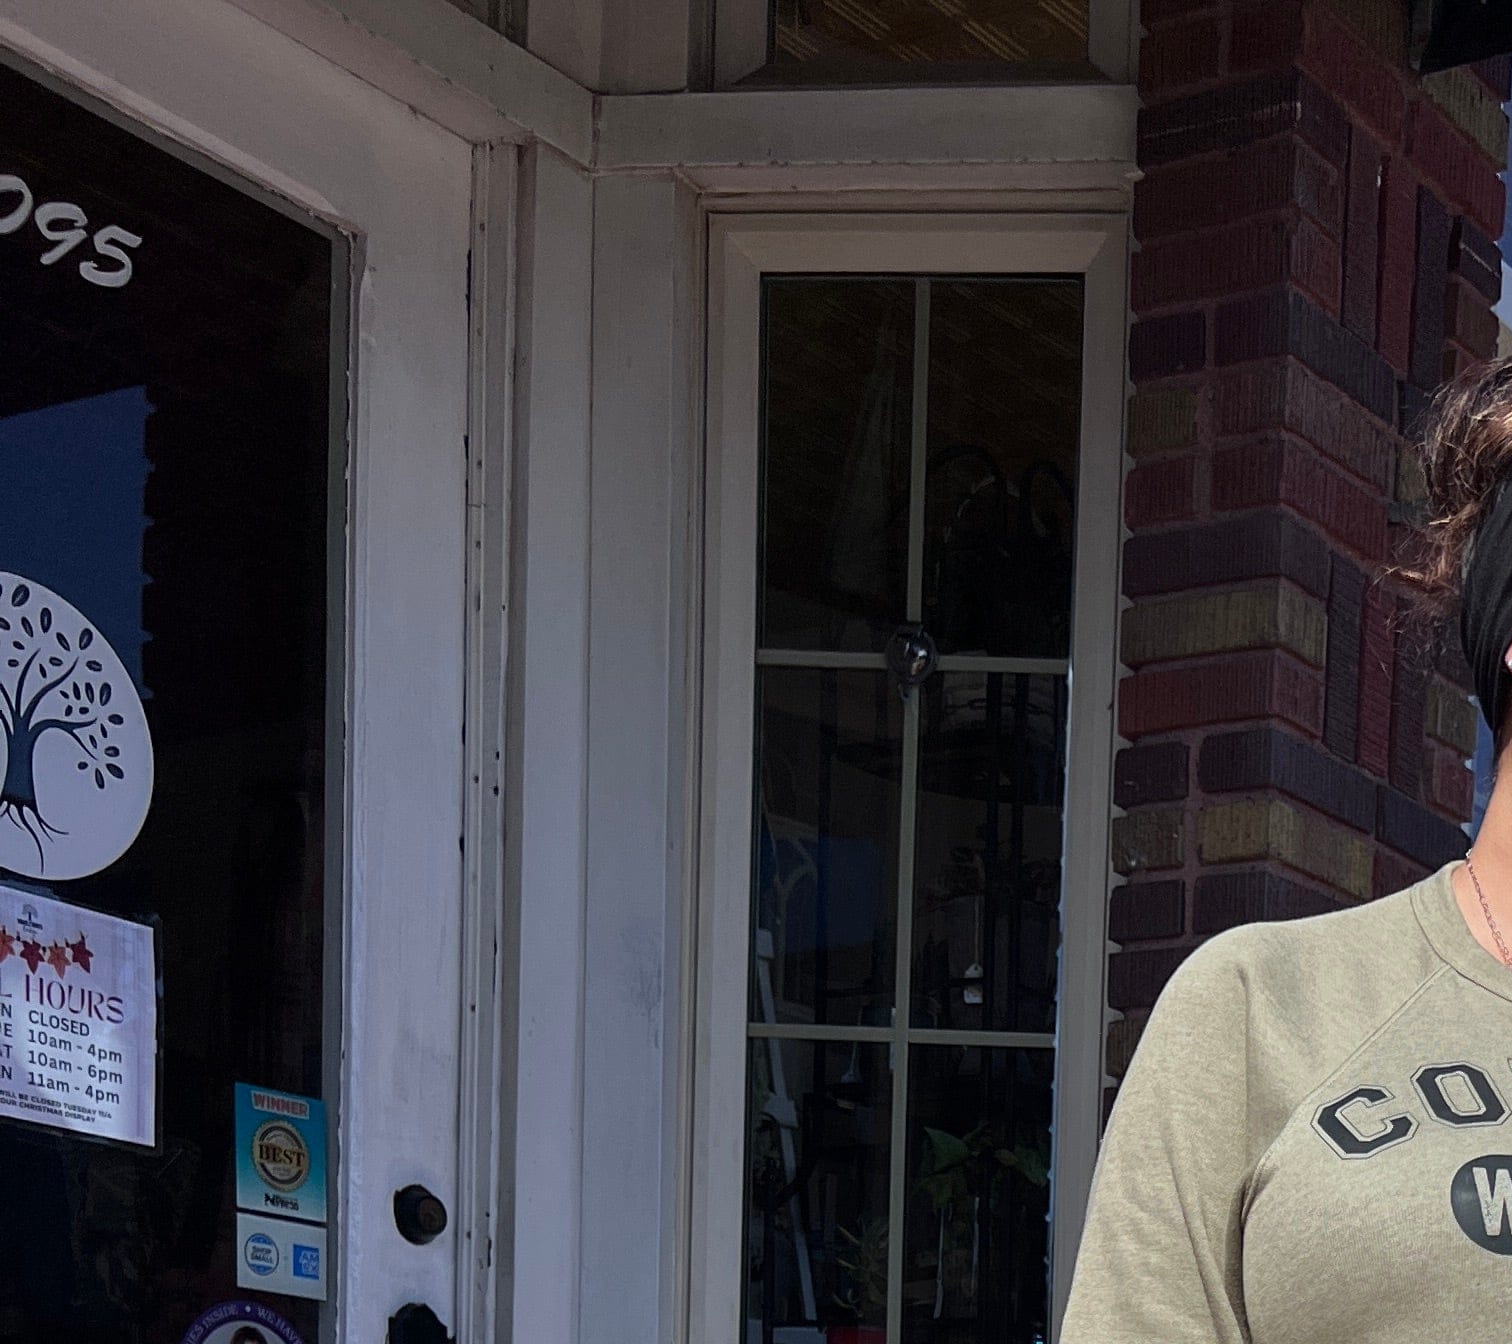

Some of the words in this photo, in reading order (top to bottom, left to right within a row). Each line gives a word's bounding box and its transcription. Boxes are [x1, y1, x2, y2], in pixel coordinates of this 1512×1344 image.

[26, 974, 124, 1024] HOURS
[29, 1010, 90, 1037] CLOSED
[28, 1029, 72, 1052] 10am
[87, 1044, 122, 1063] 4pm
[28, 1050, 72, 1073] 10am
[88, 1065, 122, 1084] 6pm
[28, 1072, 70, 1093] 11am
[85, 1085, 119, 1104] 4pm
[31, 1096, 61, 1108] CLOSED
[253, 1093, 308, 1116] WINNER
[64, 1112, 96, 1123] DISPLAY
[259, 1143, 305, 1168] BEST
[257, 1306, 277, 1323] WE
